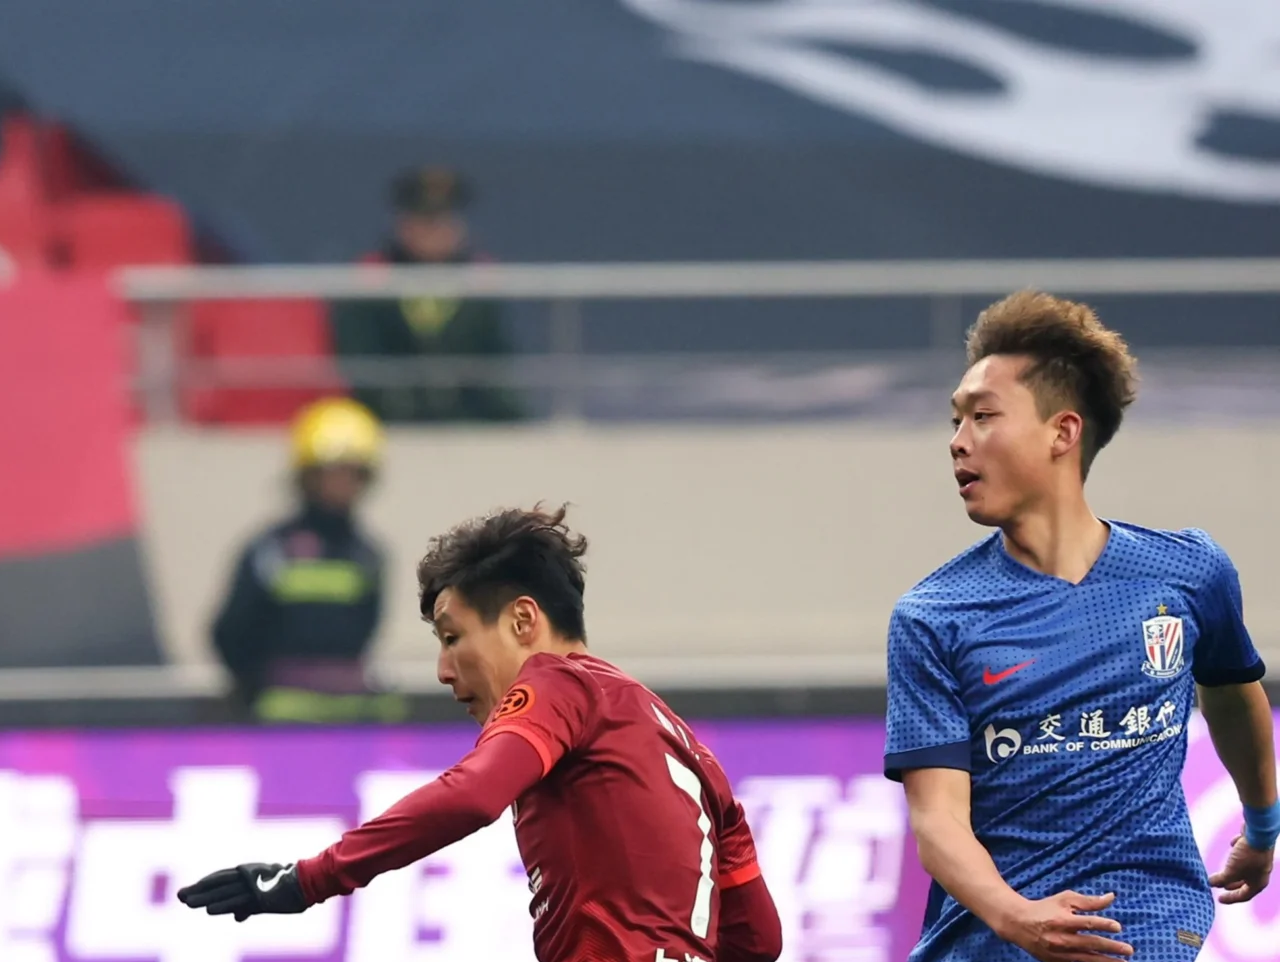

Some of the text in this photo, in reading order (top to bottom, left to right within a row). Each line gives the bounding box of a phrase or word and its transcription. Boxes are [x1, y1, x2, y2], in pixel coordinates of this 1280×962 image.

[1036, 700, 1177, 742] 交通銀行
[1023, 743, 1059, 756] BANK
[1065, 741, 1085, 752] OF
